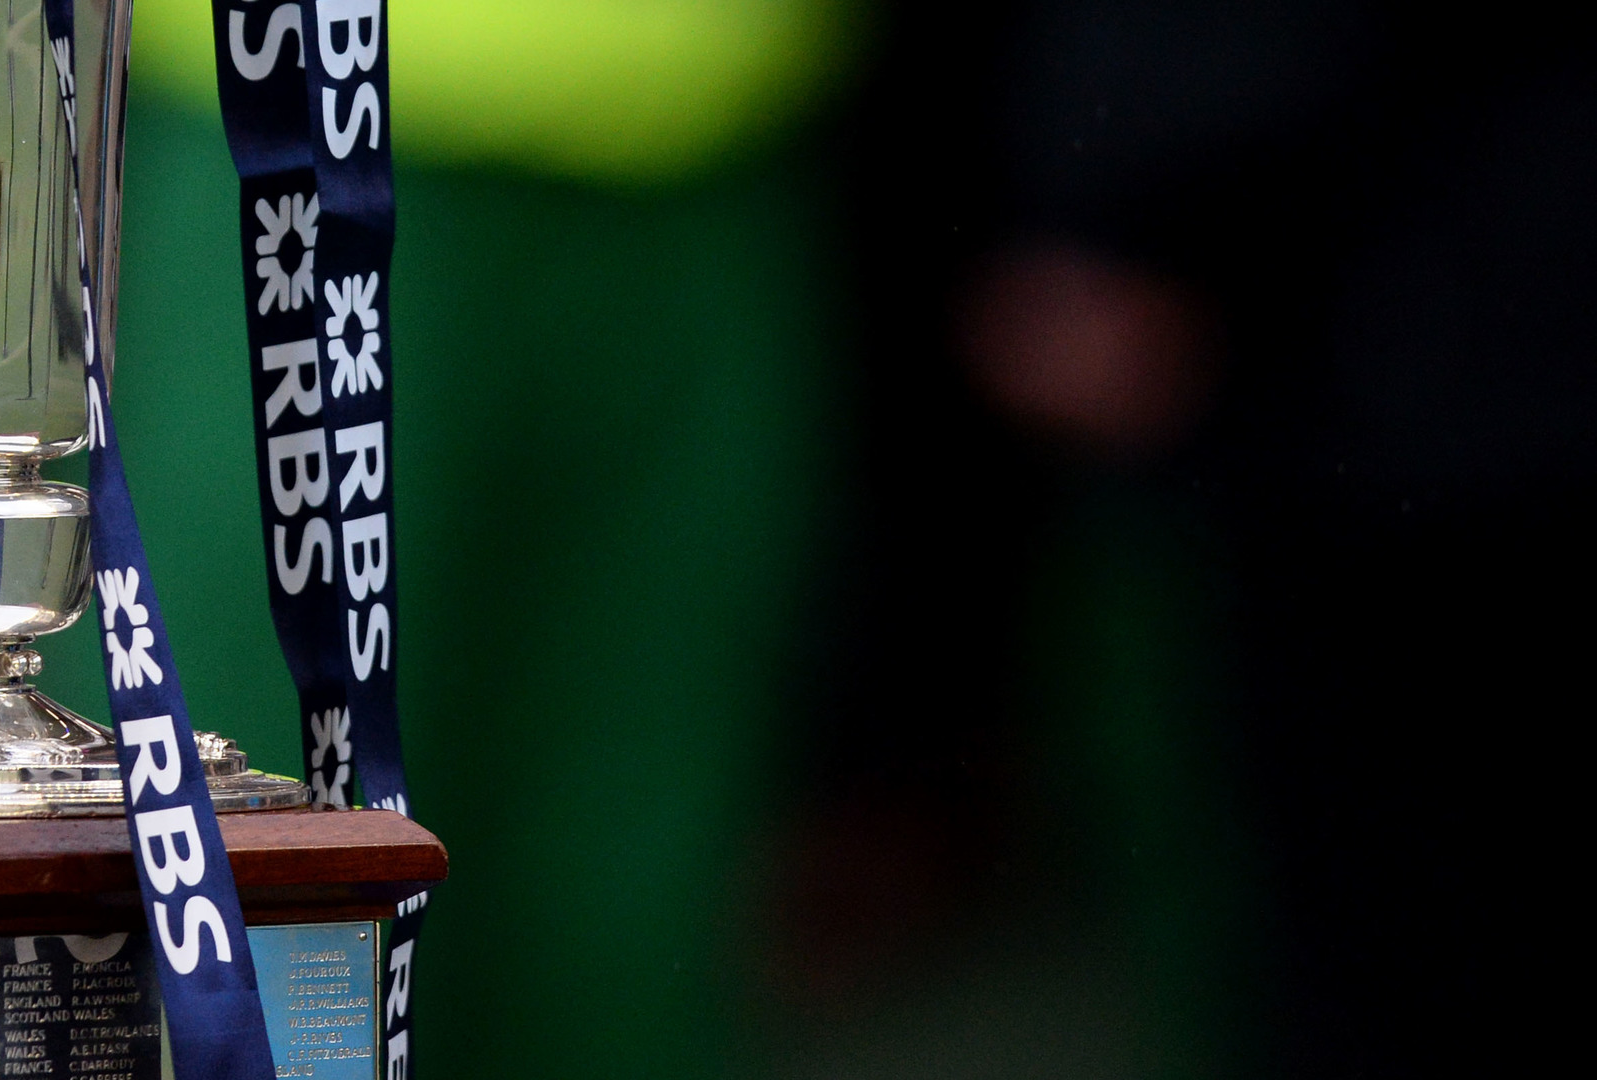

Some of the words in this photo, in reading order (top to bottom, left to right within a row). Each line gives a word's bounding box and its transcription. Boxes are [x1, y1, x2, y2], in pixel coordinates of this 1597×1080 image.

[261, 337, 335, 596] RBS
[334, 420, 392, 683] RBS
[120, 714, 232, 976] RBS
[2, 962, 52, 978] FRANCE
[3, 978, 53, 993] FRANCE
[3, 994, 62, 1010] ENGLAND
[3, 1009, 70, 1025] SCOTLAND
[72, 1007, 116, 1021] WALES
[5, 1028, 46, 1043] WALES
[5, 1045, 46, 1059] WALES
[4, 1059, 54, 1076] FRANCE
